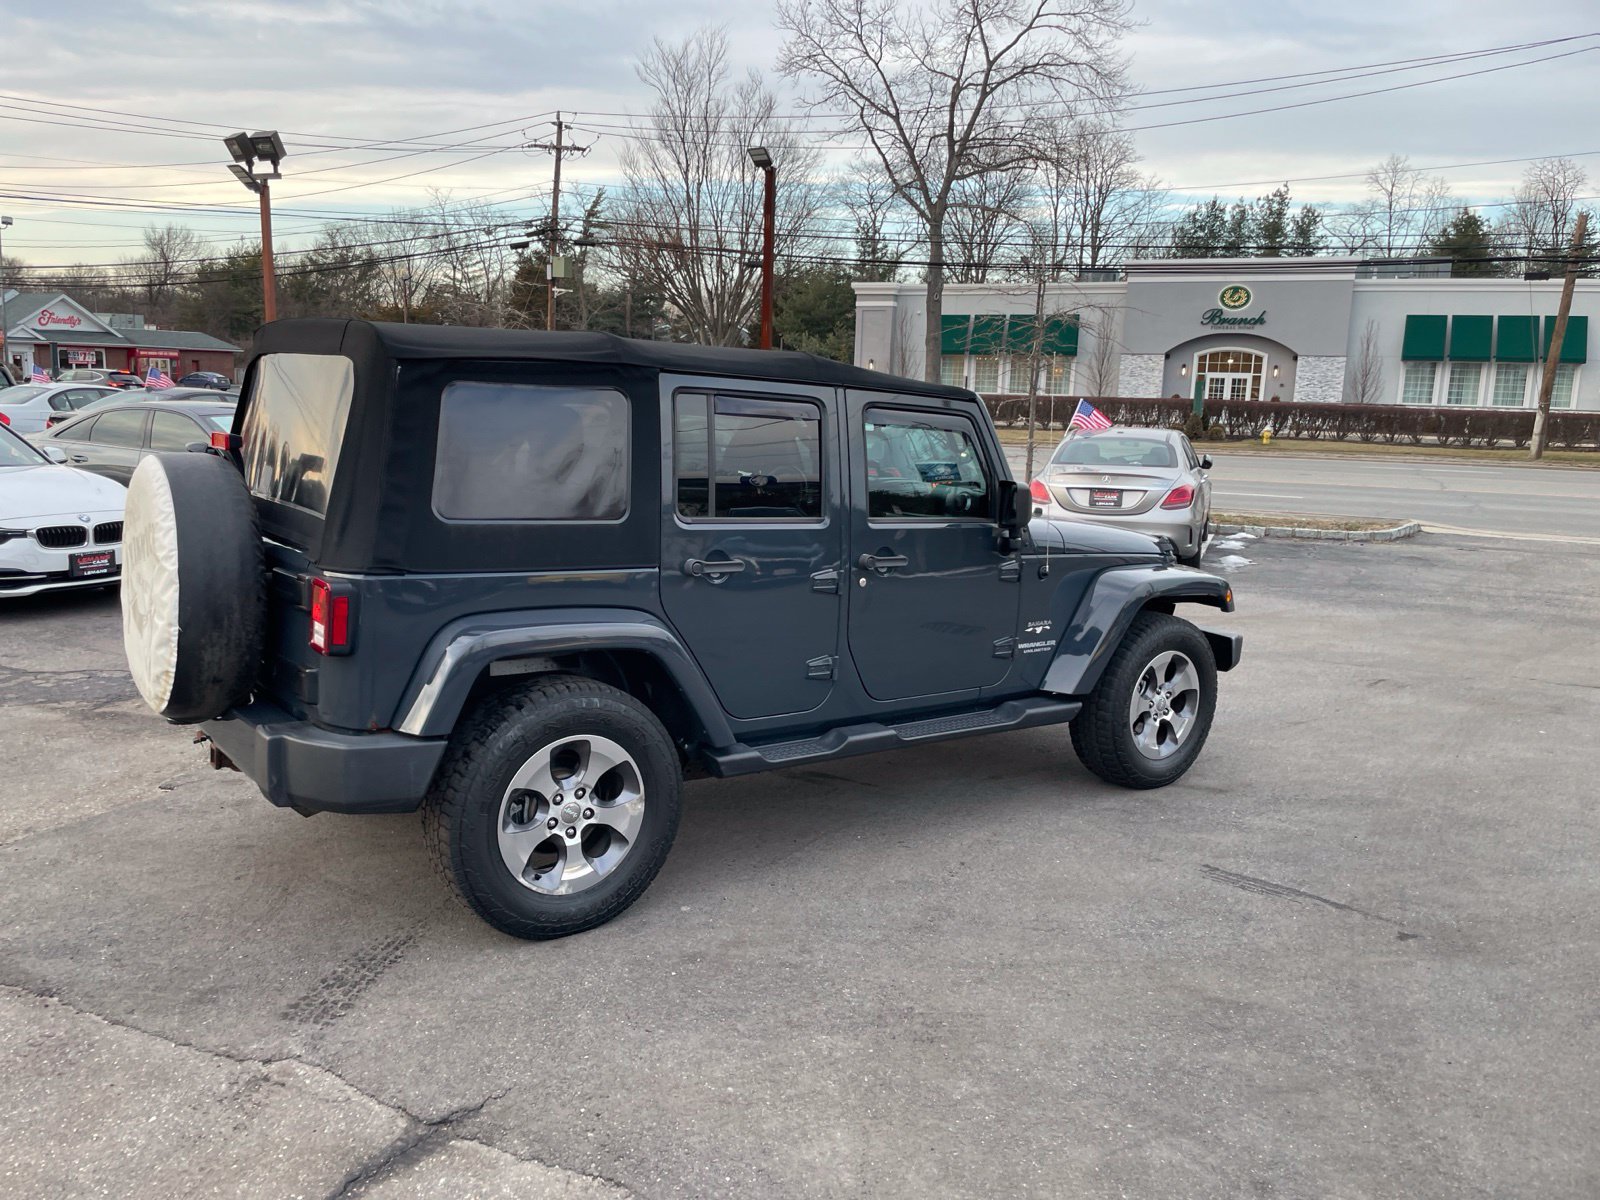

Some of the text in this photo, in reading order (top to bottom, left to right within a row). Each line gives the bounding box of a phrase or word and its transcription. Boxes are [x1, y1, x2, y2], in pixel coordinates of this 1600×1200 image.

[38, 309, 81, 328] Friendly's
[1200, 308, 1267, 326] Branch
[1018, 640, 1056, 649] WRANGLER
[1023, 646, 1051, 654] UNLIMITED
